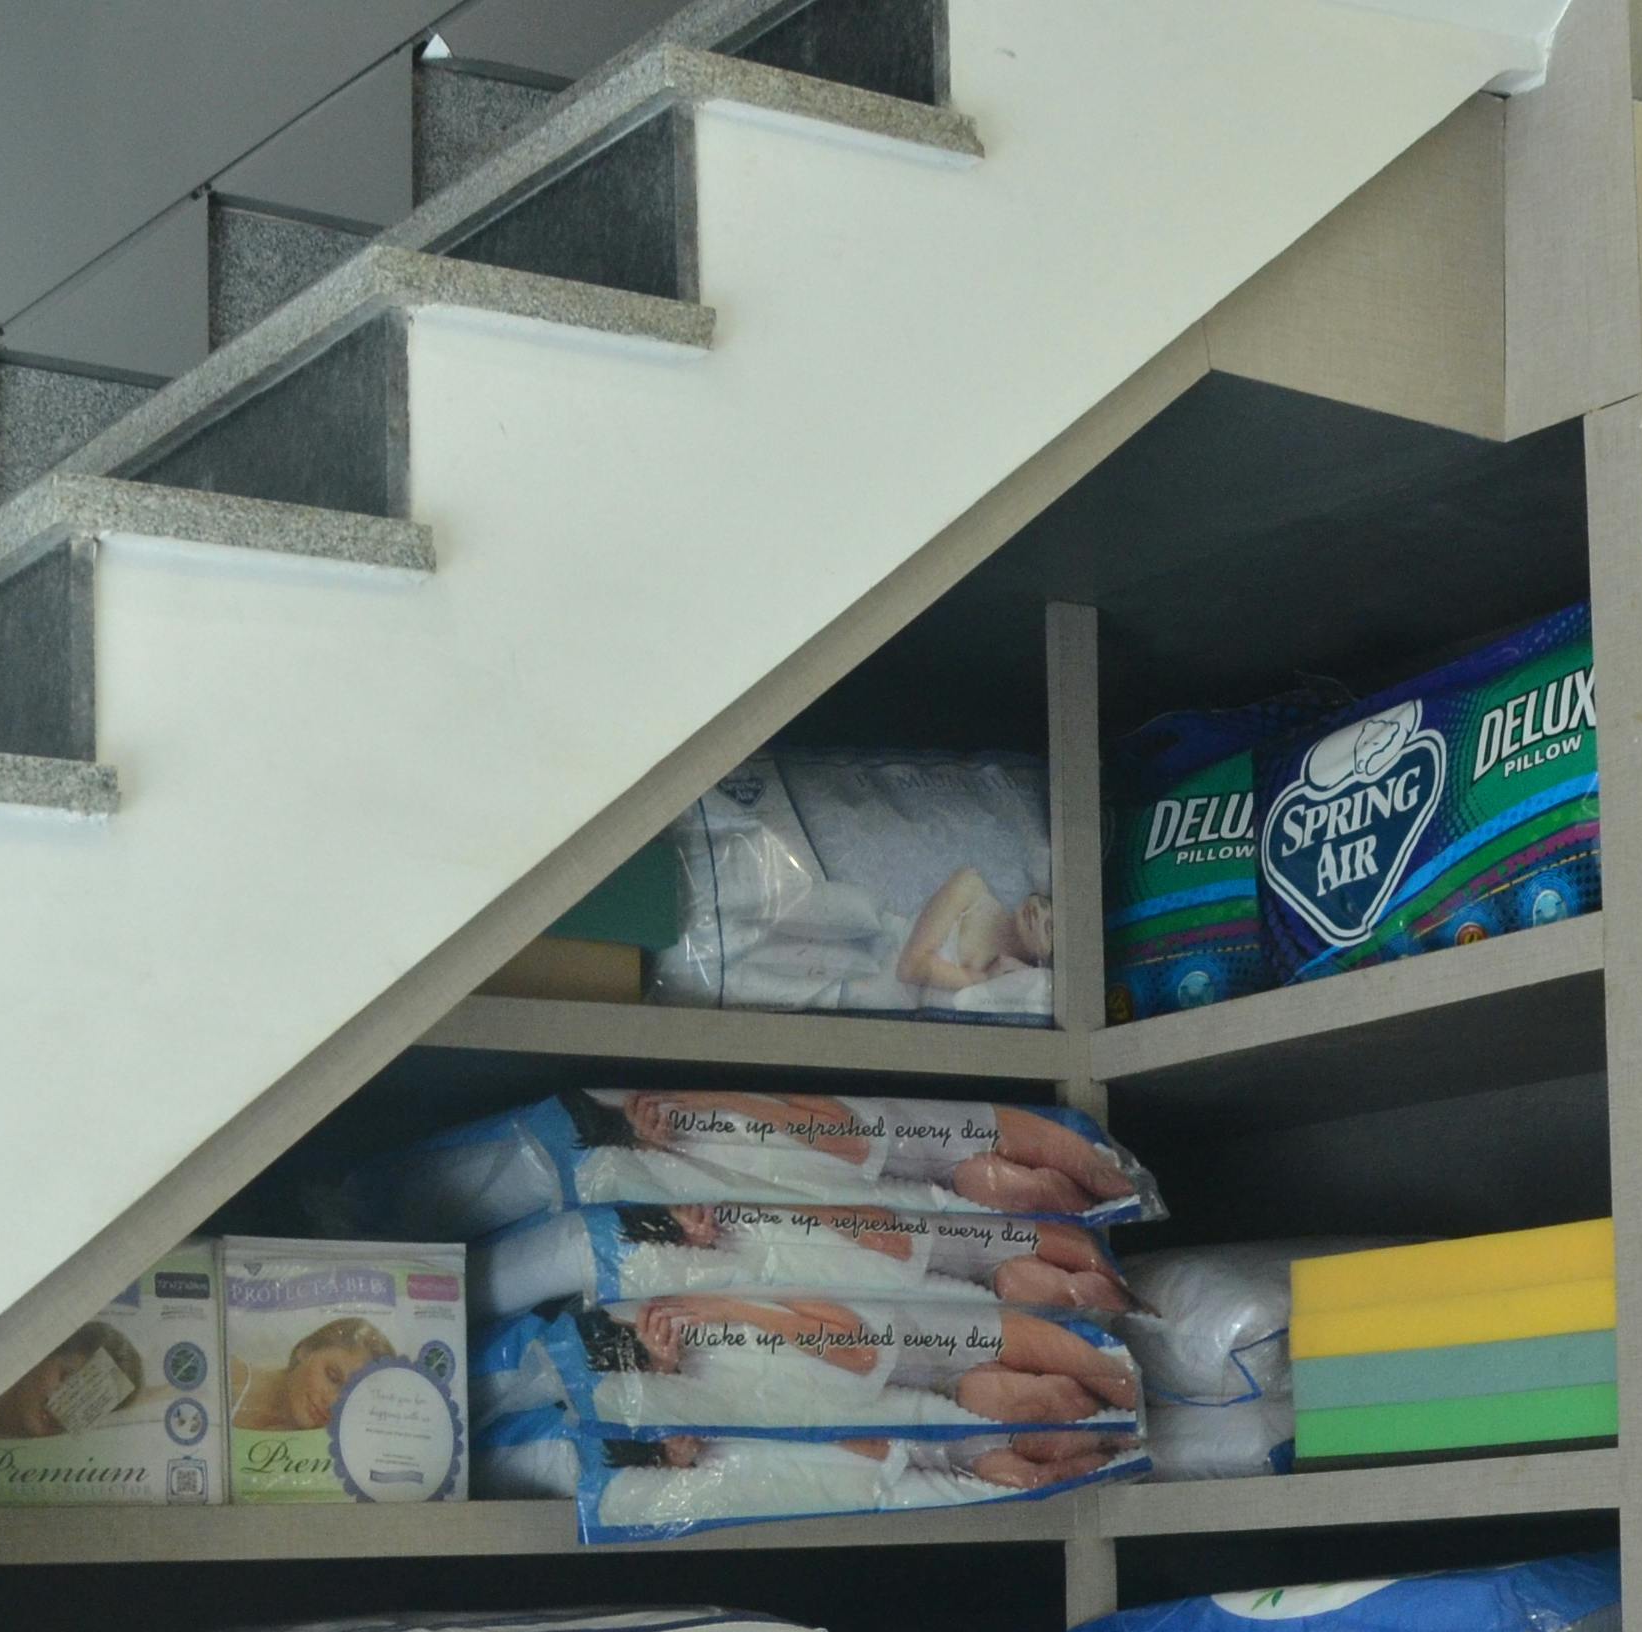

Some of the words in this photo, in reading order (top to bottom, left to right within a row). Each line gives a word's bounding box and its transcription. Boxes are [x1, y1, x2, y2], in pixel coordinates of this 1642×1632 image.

[1504, 734, 1582, 778] PILLOW
[1143, 792, 1253, 862] DELU
[1281, 764, 1421, 857] SPRING
[1176, 845, 1255, 865] PILLOW
[1316, 834, 1379, 897] AIR
[669, 1110, 735, 1133] Wake
[746, 1121, 776, 1142] up
[787, 1116, 886, 1142] refreshed
[896, 1124, 952, 1147] every
[960, 1118, 1001, 1147] day
[714, 1206, 781, 1225] Wake
[792, 1214, 822, 1235] up
[830, 1211, 929, 1234] refreshed
[938, 1223, 993, 1247] every
[1001, 1220, 1040, 1247] day
[680, 1324, 747, 1346] Wake
[757, 1335, 786, 1353] up
[795, 1324, 895, 1356] refreshed
[904, 1335, 957, 1356] every
[966, 1328, 1004, 1358] day
